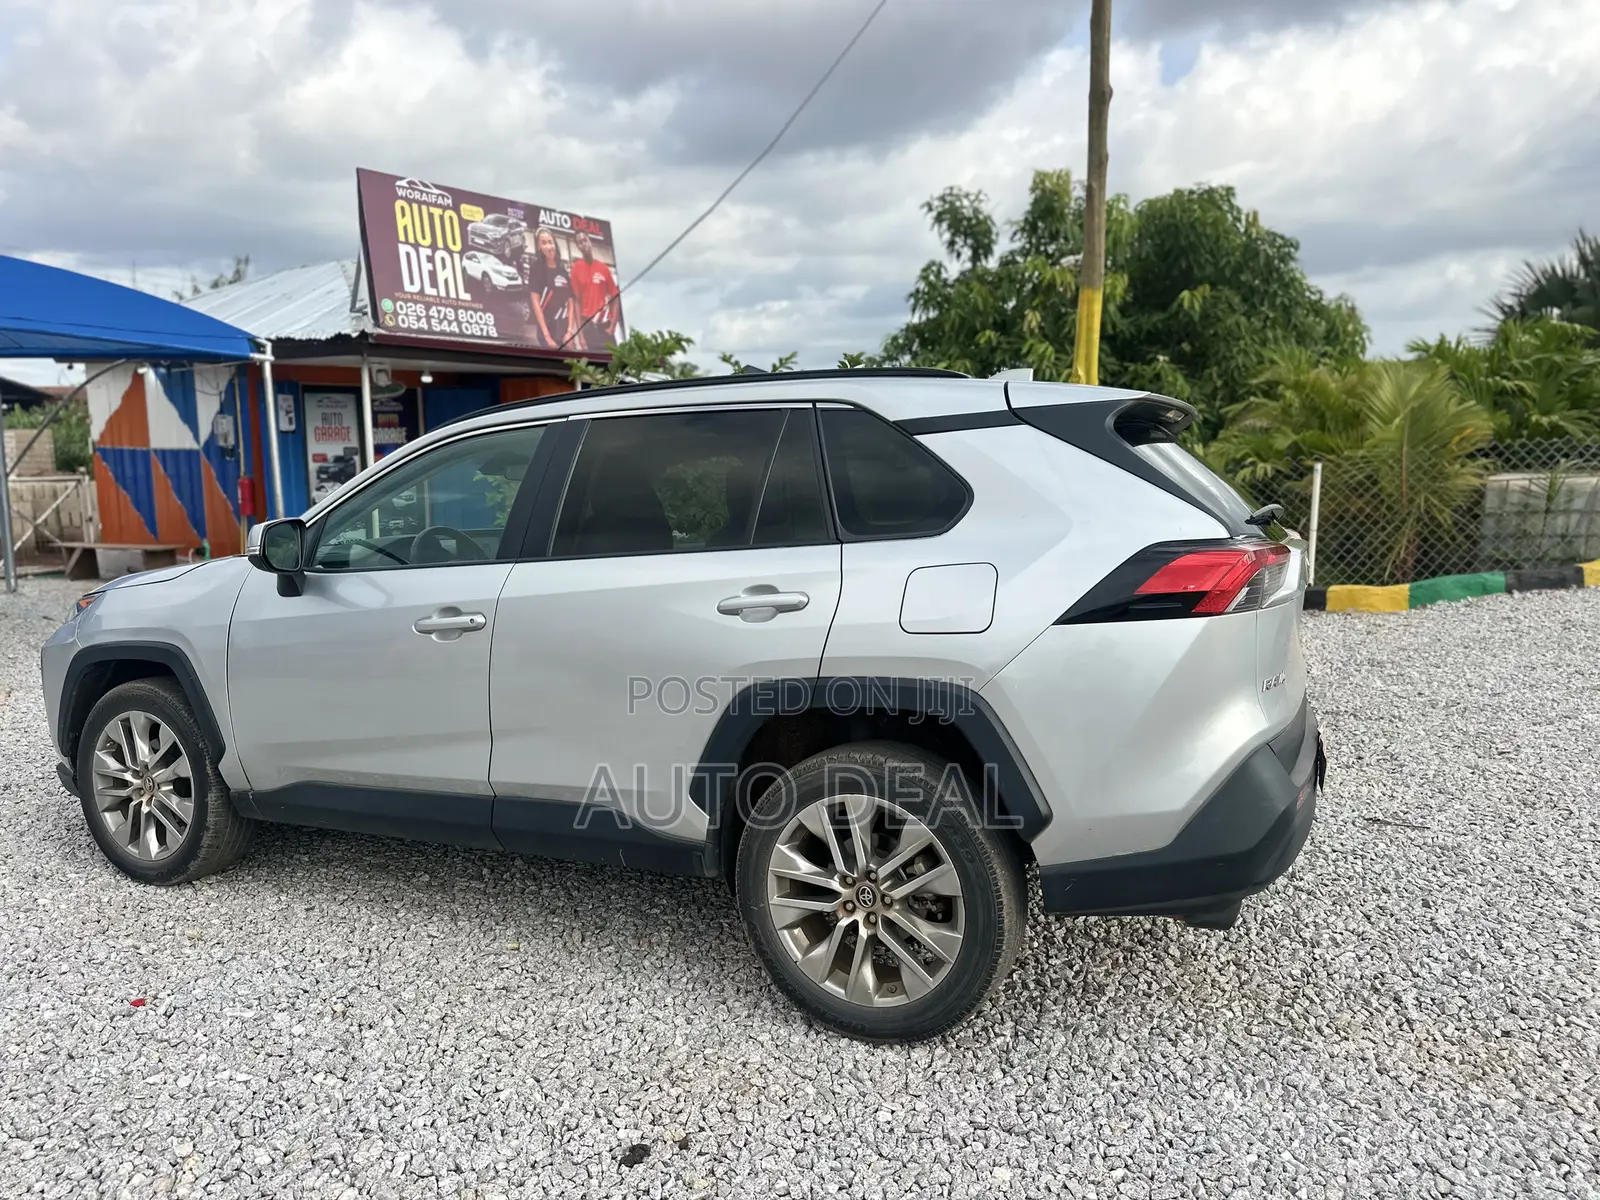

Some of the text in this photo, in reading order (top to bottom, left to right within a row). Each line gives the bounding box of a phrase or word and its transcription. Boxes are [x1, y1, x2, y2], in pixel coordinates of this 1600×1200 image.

[395, 186, 453, 207] WORAIFAM
[395, 199, 462, 252] AUTO
[539, 209, 603, 235] AUTO DEAL
[398, 243, 471, 301] DEAL
[396, 301, 495, 325] 026 479 8009
[413, 294, 440, 304] RELIABLE
[458, 301, 484, 309] PARTNER
[398, 314, 498, 338] 054 544 0878
[321, 412, 343, 426] AUTO
[314, 426, 352, 442] GARAGE
